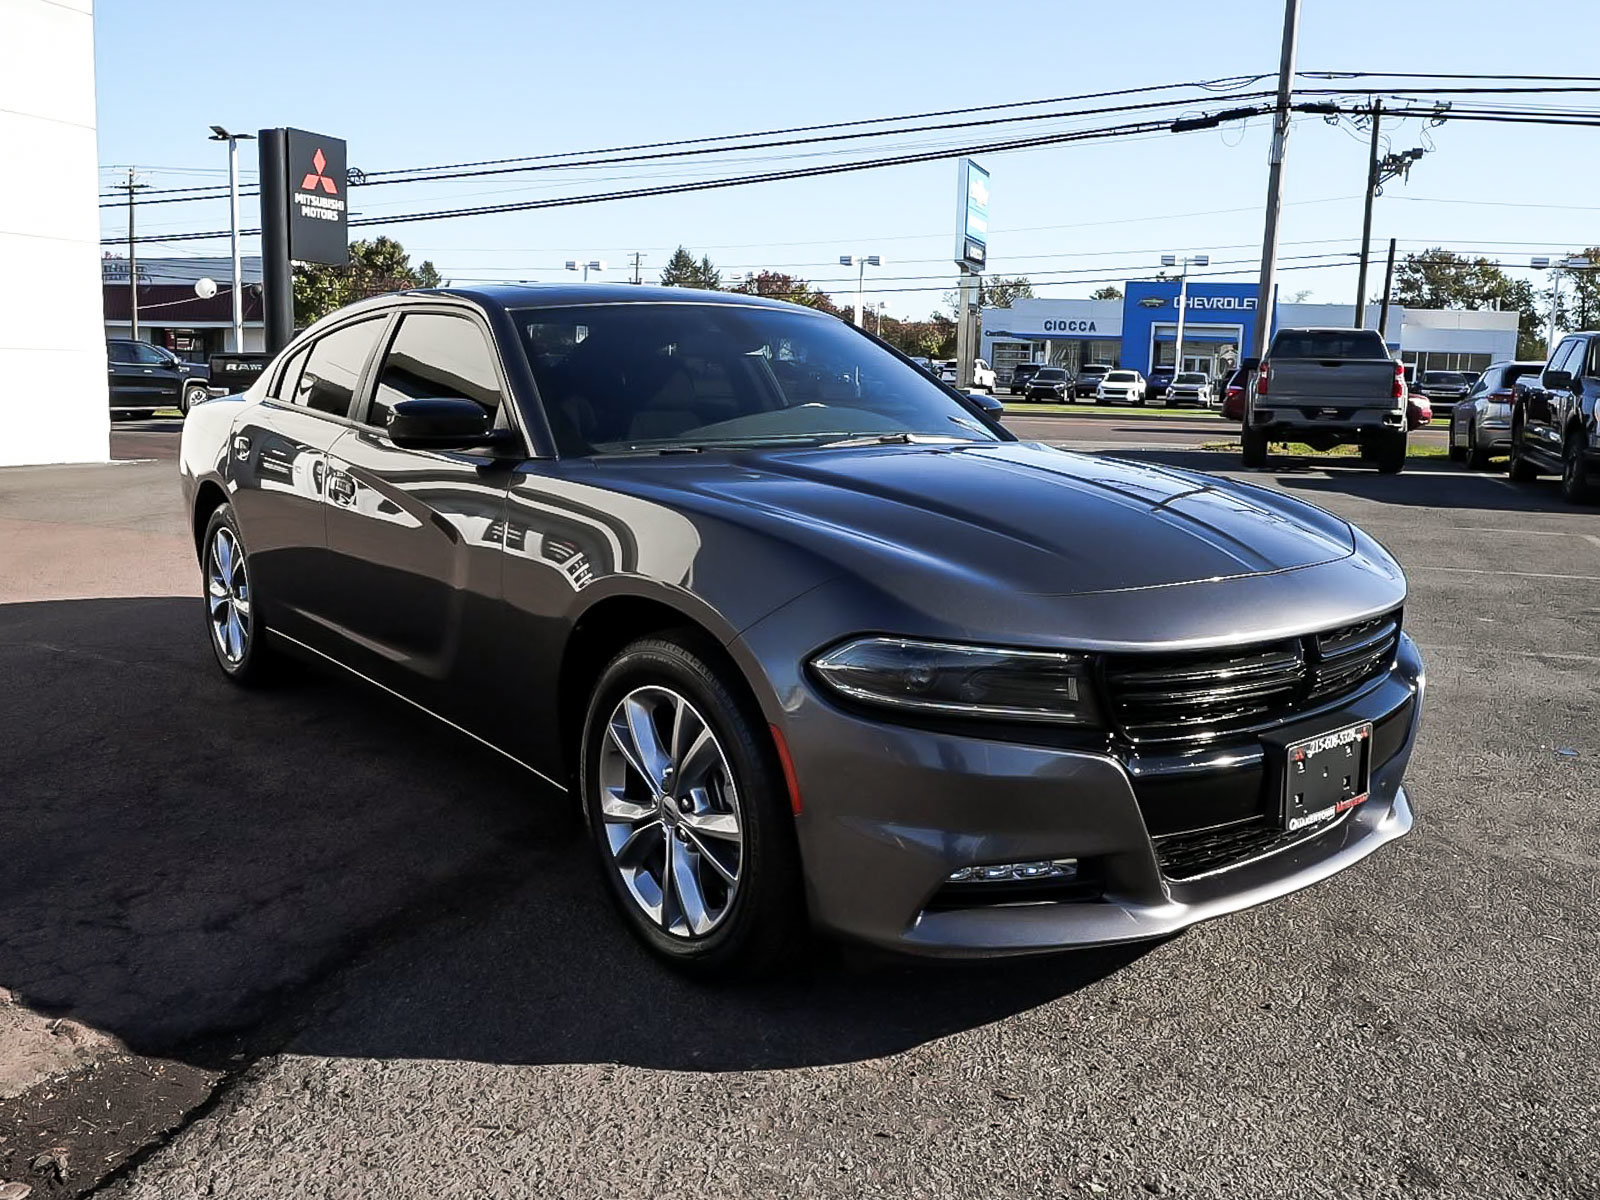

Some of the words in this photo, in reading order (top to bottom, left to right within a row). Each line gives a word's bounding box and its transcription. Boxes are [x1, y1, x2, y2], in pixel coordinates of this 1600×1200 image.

[294, 192, 345, 211] MITSUBISHI
[301, 206, 339, 221] MOTORS
[1173, 296, 1259, 310] CHEVROLET
[1044, 319, 1097, 332] CIOCCA
[225, 363, 263, 371] RAM
